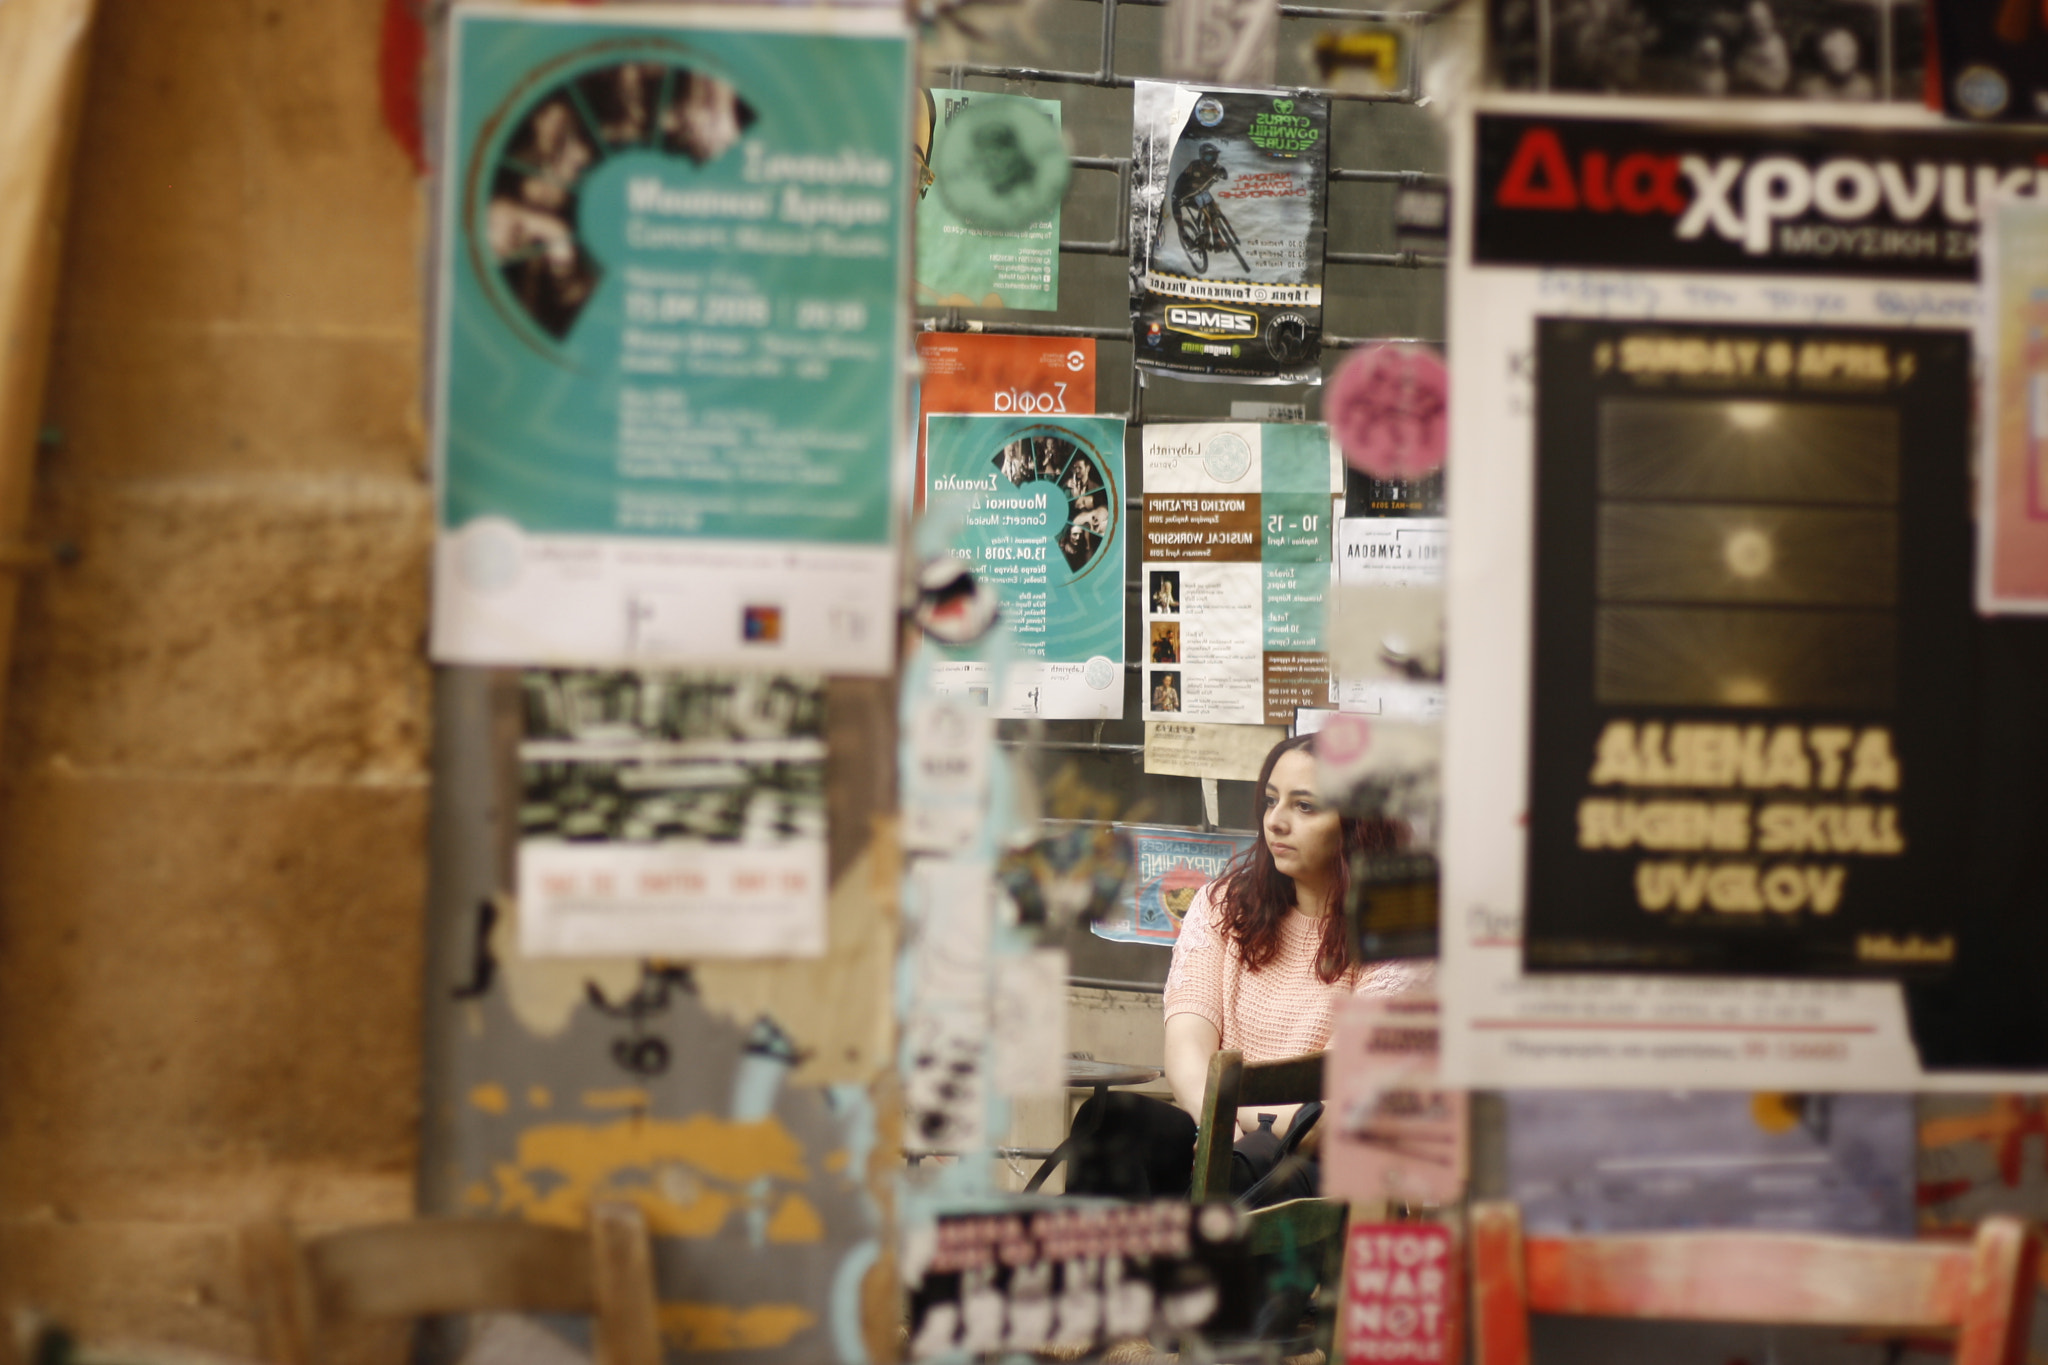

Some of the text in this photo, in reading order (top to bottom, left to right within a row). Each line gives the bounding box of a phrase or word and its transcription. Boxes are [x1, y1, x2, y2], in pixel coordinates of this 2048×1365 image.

[1758, 803, 1902, 855] SKULL
[1354, 1235, 1446, 1267] STOP
[1354, 1269, 1444, 1298] WAR
[1351, 1302, 1443, 1337] NOT
